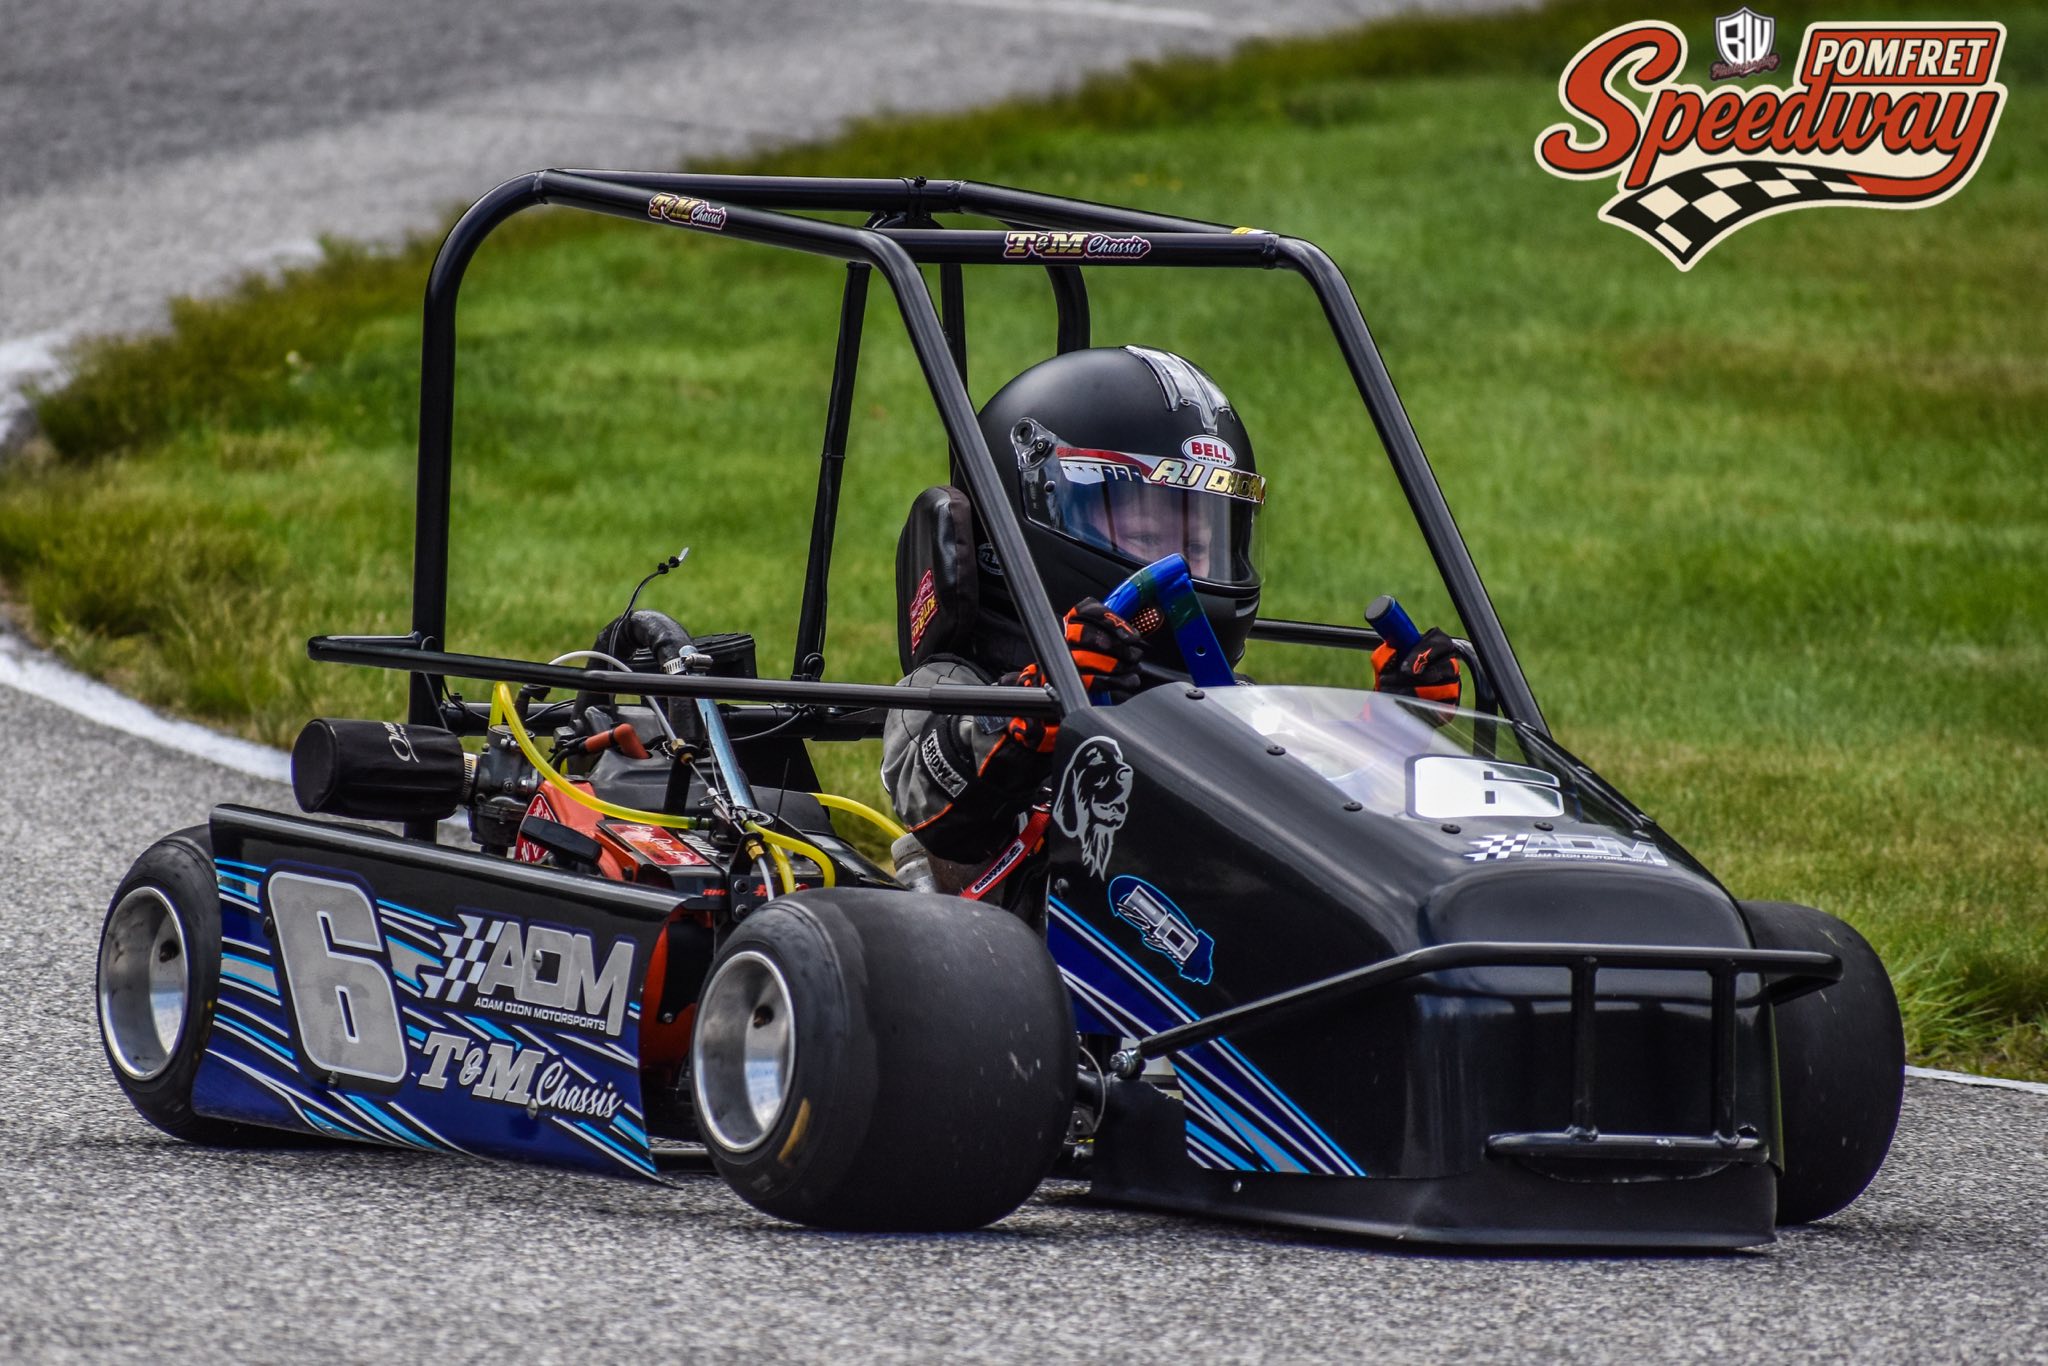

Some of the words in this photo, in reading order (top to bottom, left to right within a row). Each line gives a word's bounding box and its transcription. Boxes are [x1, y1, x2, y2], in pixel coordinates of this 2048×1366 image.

[650, 194, 701, 220] T&M
[1008, 233, 1088, 254] T&M
[1087, 235, 1147, 254] Chassis
[1191, 441, 1231, 461] BELL
[1197, 456, 1227, 465] HELMETS
[1149, 458, 1205, 487] AJ
[926, 736, 953, 780] CROW
[1414, 755, 1564, 819] 6
[268, 870, 407, 1084] 6
[477, 920, 635, 1036] ADM
[474, 997, 503, 1012] ADAM
[504, 1002, 532, 1017] DION
[533, 1008, 607, 1031] MOTORSPORTS
[418, 1031, 545, 1105] T&M
[536, 1062, 622, 1119] Chassis
